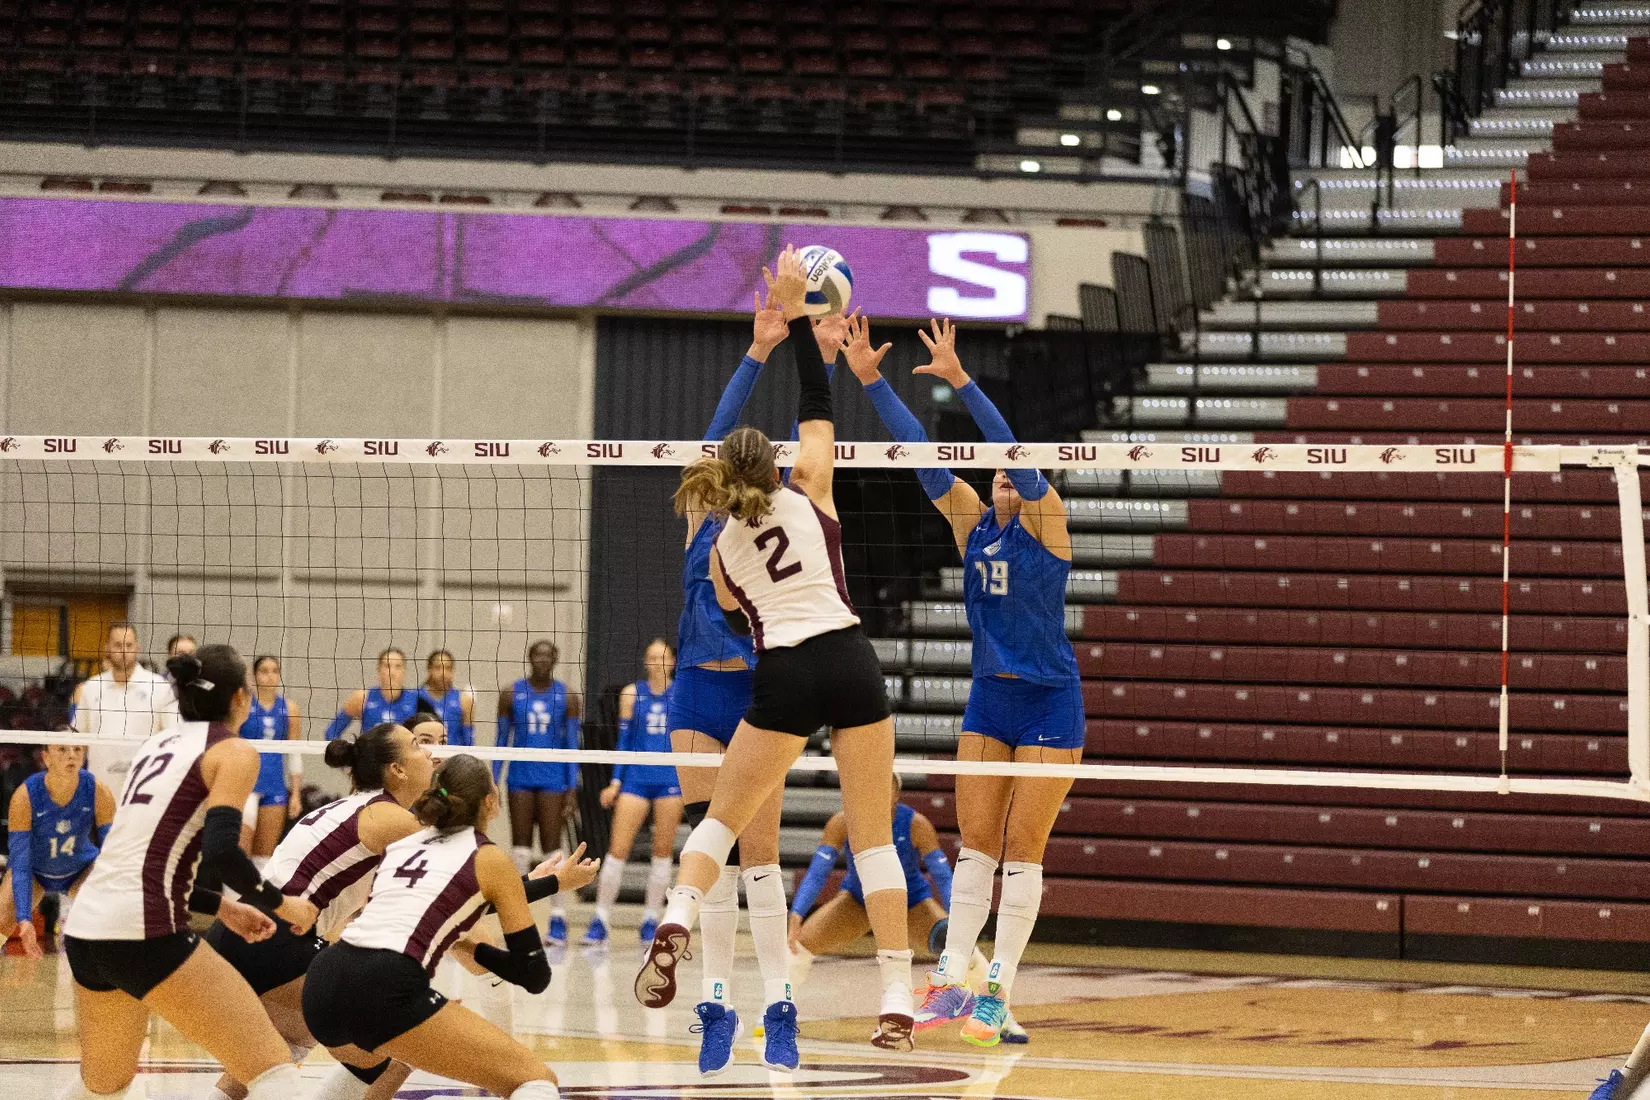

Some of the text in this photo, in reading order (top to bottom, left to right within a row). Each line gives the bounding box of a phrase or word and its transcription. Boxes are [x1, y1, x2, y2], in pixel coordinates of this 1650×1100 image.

[927, 233, 1028, 317] S
[44, 439, 1475, 464] SIU SIU SIU SIU SIU SIU SI IU SIU SIU SIU SIU SIU
[754, 526, 803, 583] 2
[975, 560, 1009, 596] 19
[121, 752, 175, 807] 12
[49, 835, 77, 859] 14
[393, 849, 429, 889] 4
